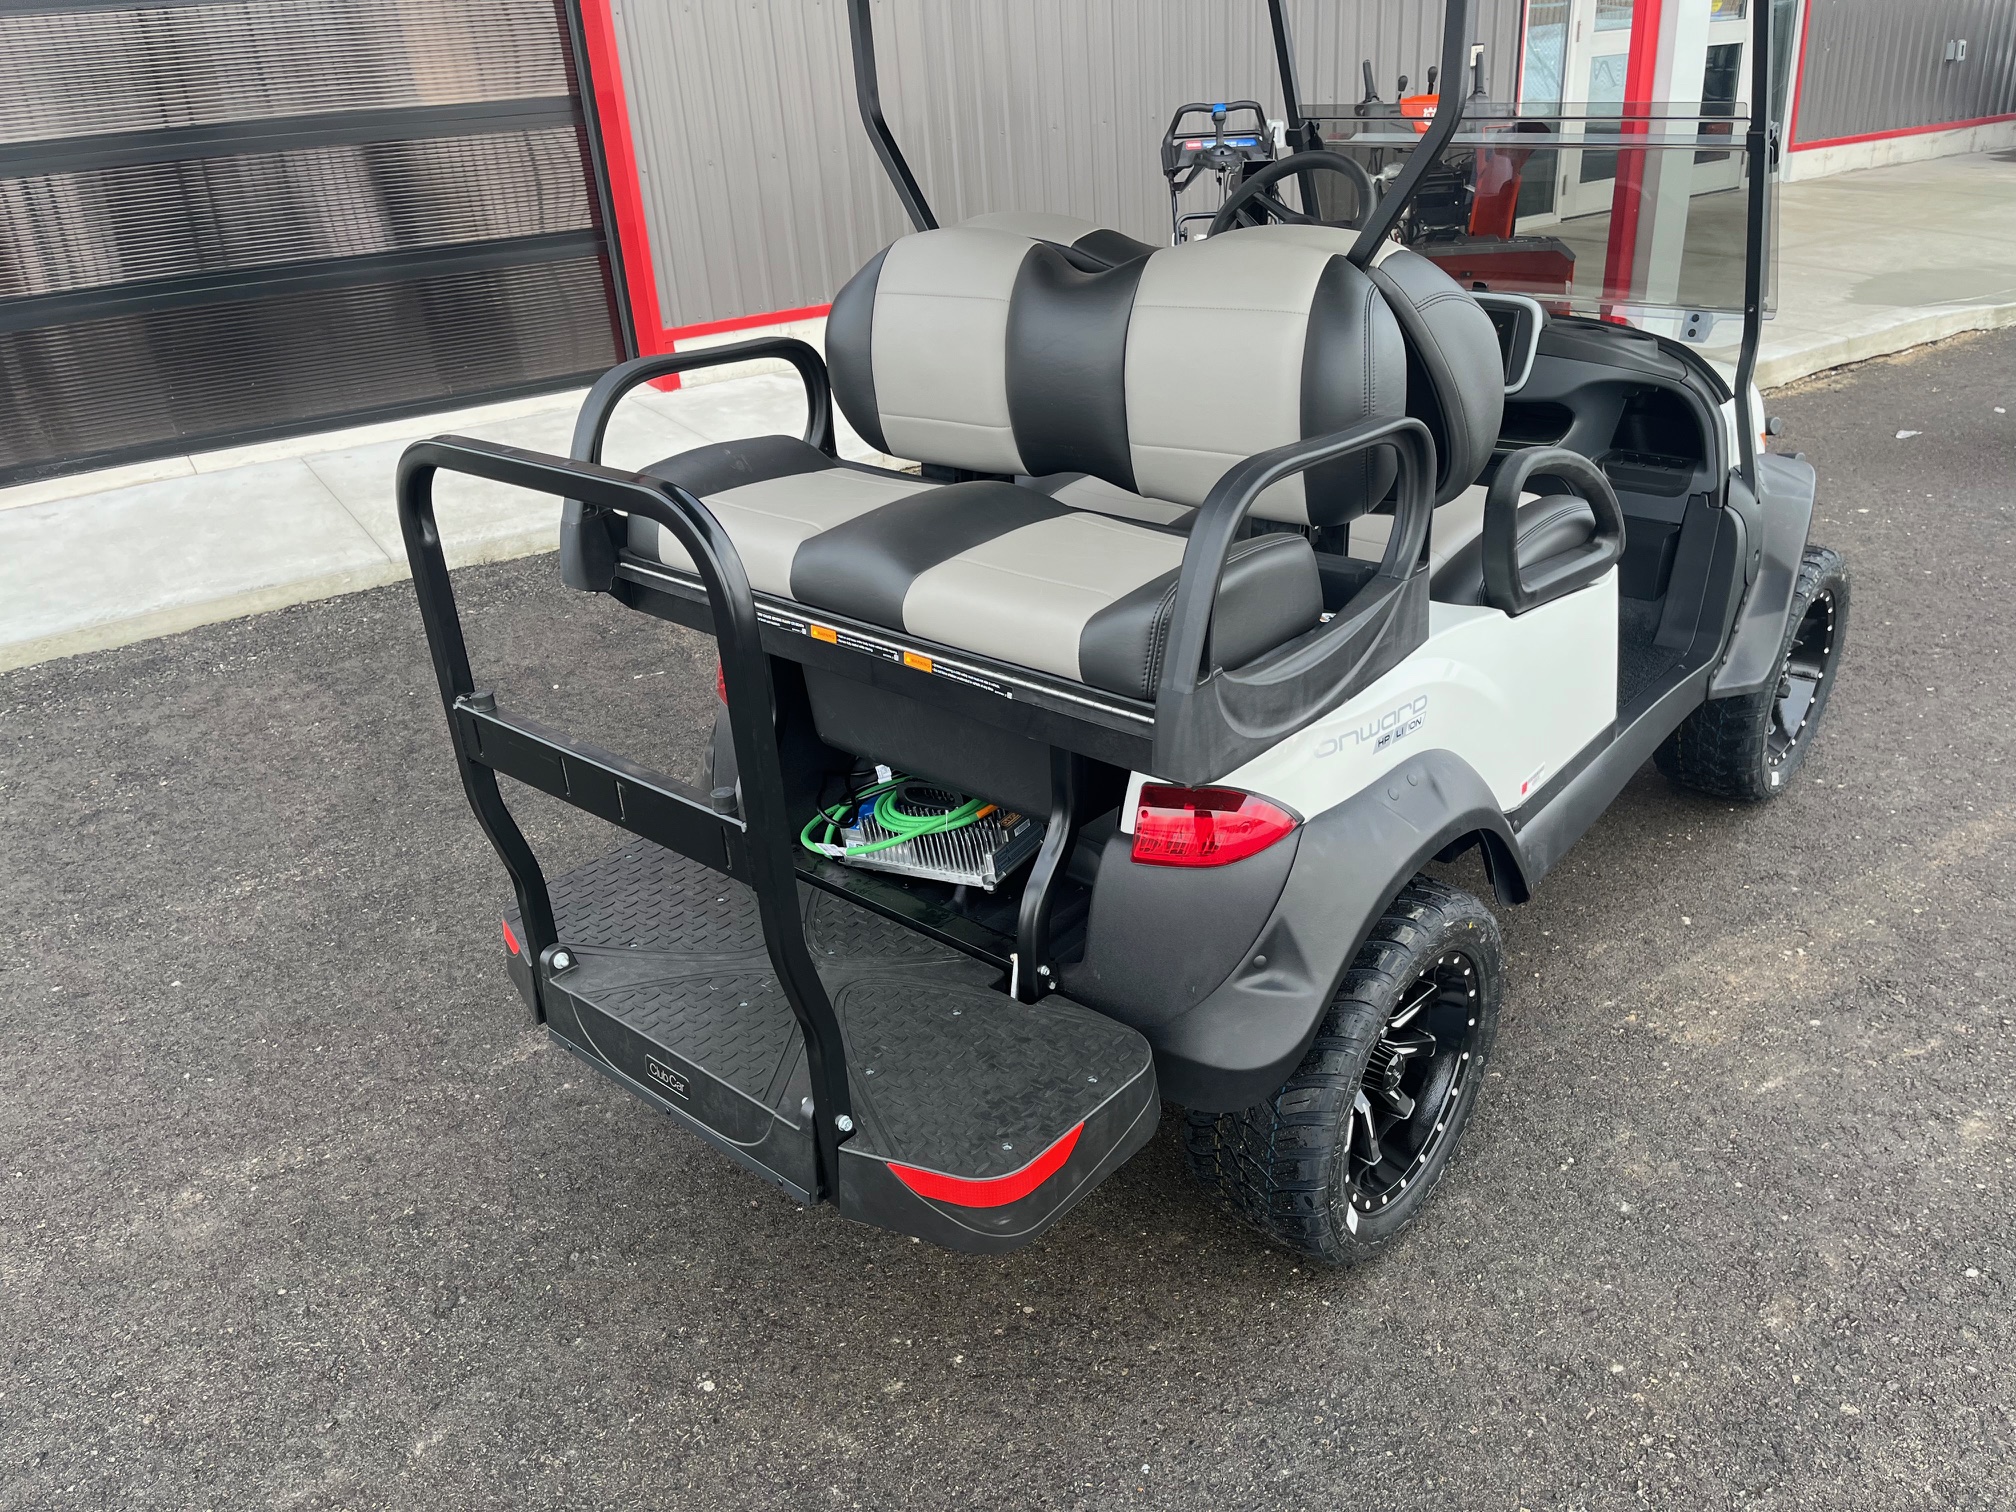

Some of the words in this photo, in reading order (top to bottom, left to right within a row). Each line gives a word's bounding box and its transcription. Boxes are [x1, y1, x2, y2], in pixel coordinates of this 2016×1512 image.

[1377, 734, 1390, 748] HP
[650, 1062, 669, 1083] Club
[669, 1075, 685, 1092] Car
